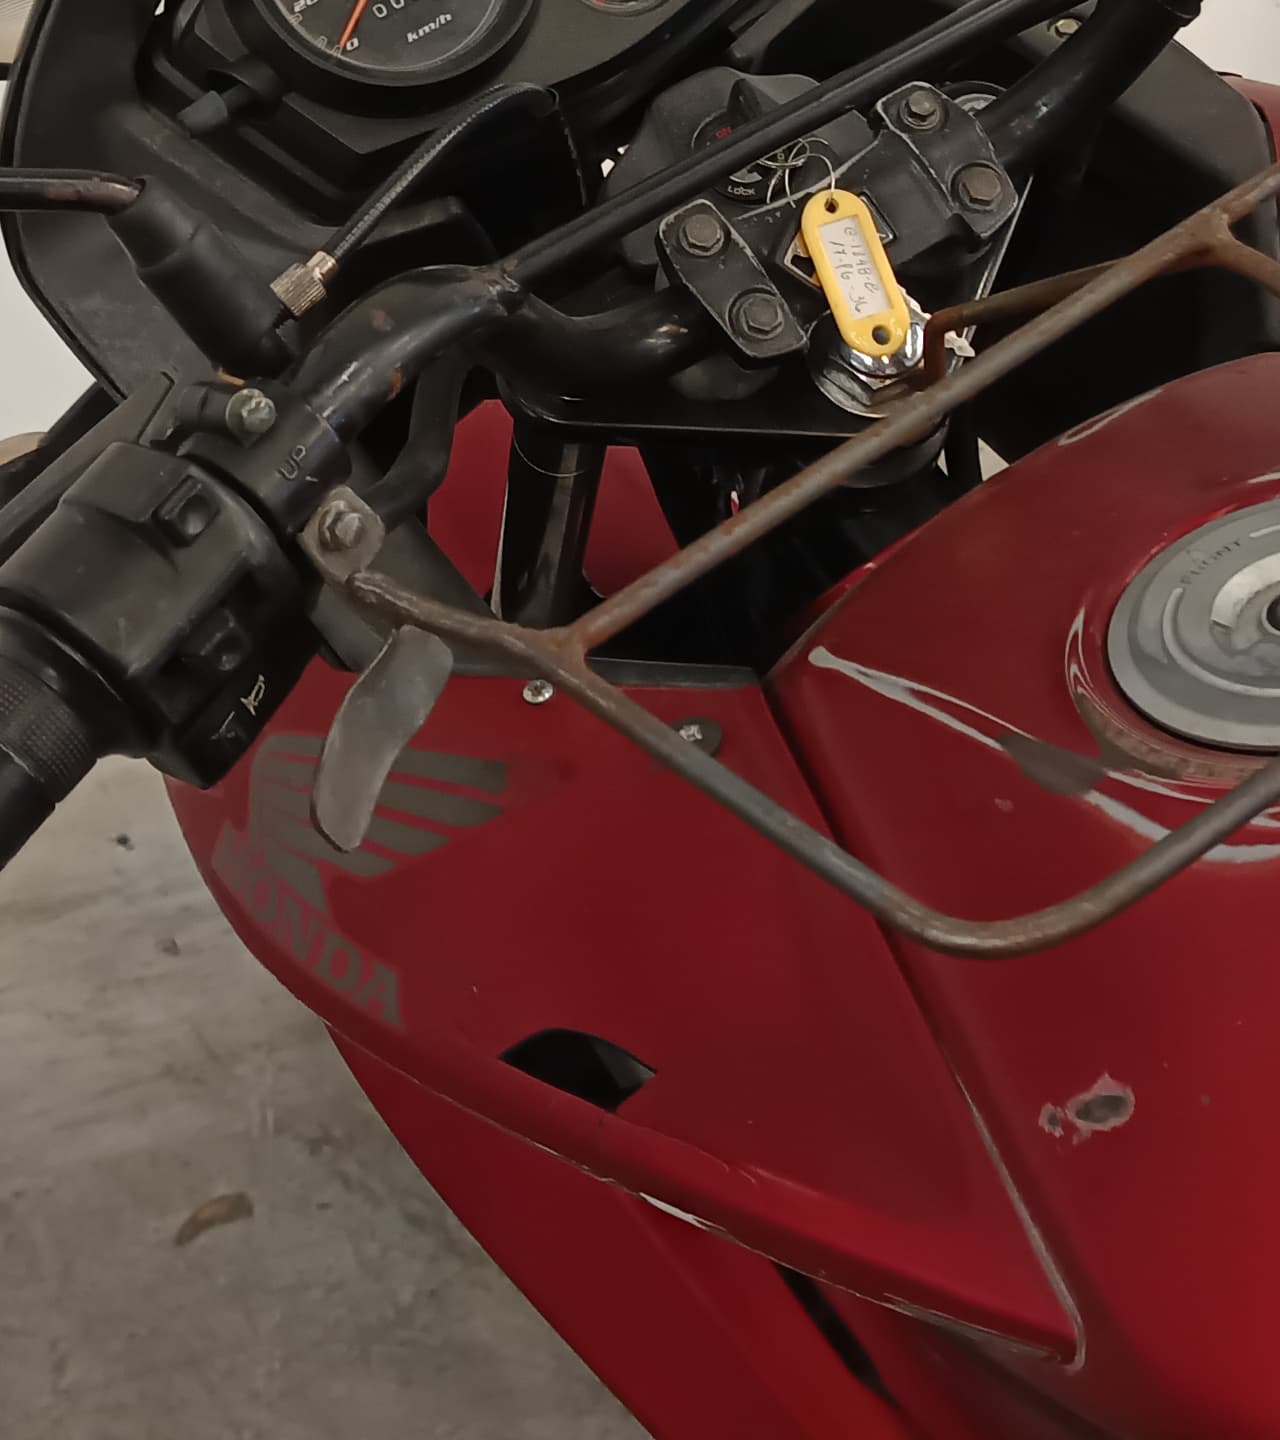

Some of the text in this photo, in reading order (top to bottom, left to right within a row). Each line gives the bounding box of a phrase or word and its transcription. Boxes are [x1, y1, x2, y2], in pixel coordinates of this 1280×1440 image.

[406, 13, 452, 43] km/h
[345, 38, 359, 51] 0
[728, 185, 756, 197] LOCK
[211, 818, 404, 1030] HONDA
